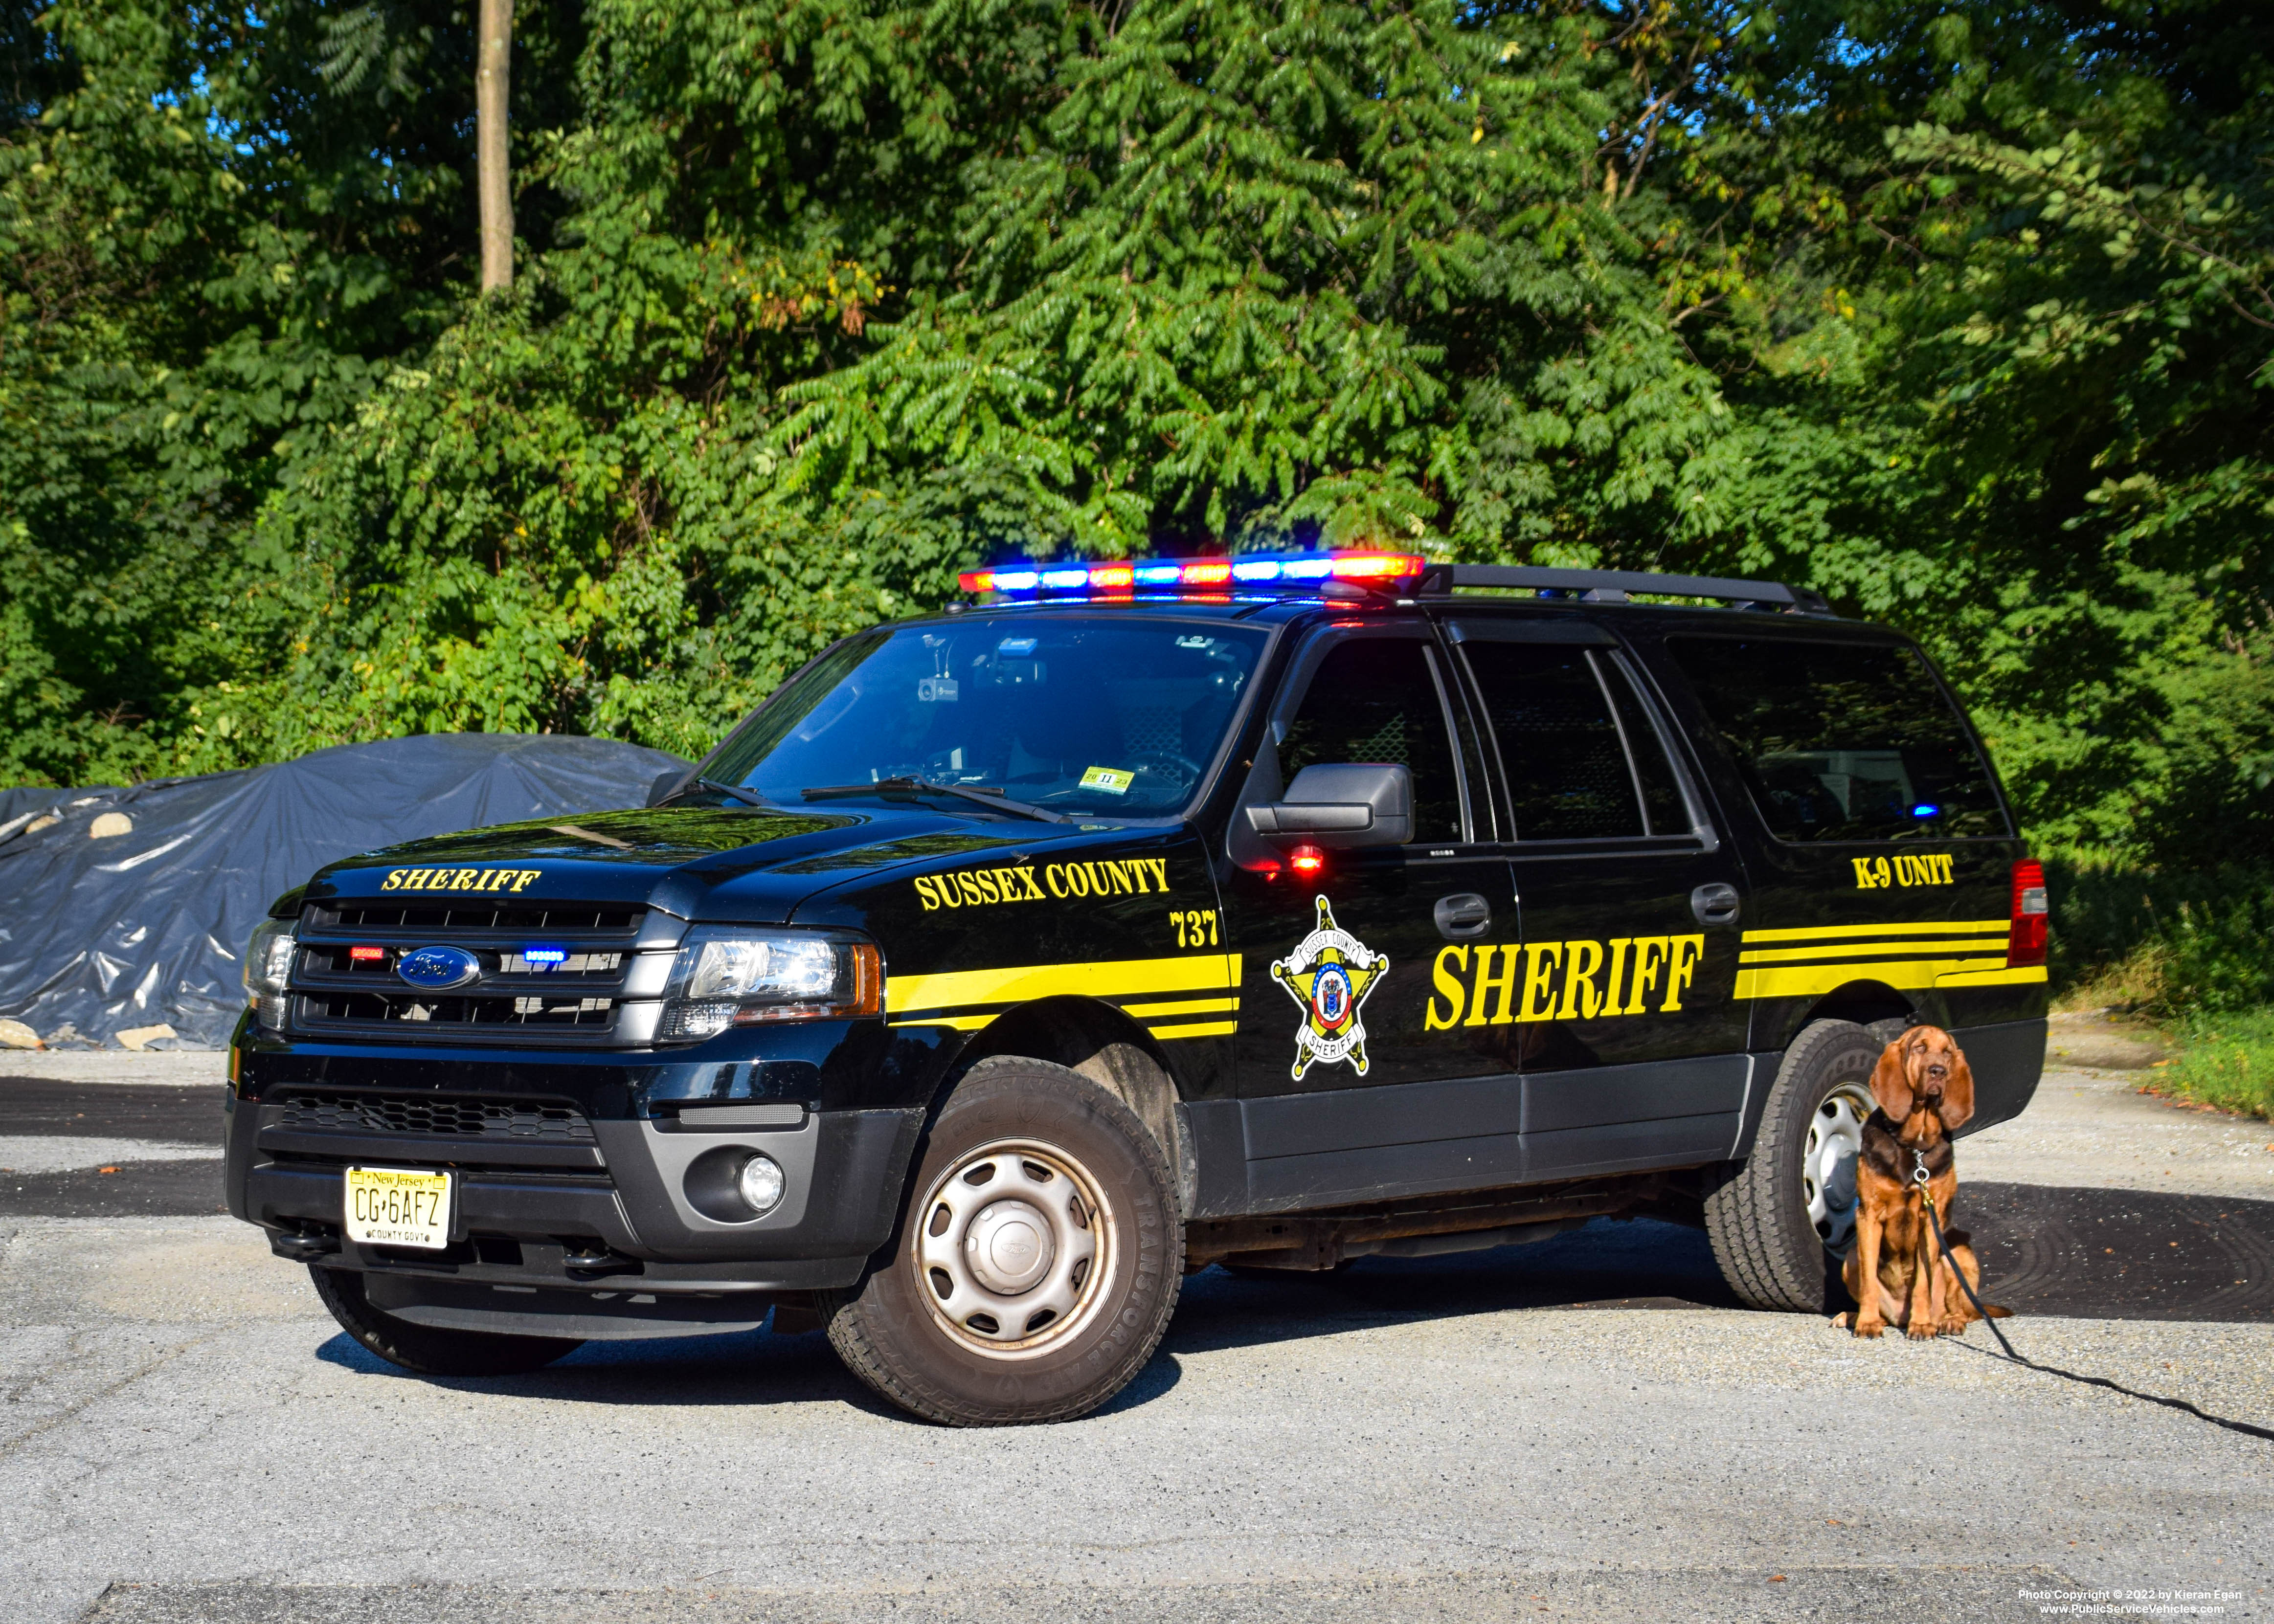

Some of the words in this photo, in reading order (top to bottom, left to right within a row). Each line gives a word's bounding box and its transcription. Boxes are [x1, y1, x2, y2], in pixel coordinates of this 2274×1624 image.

[1100, 774, 1113, 783] 11
[381, 869, 542, 892] SHERIFF
[1851, 856, 1891, 889] K-9
[1891, 854, 1954, 887] UNIT
[914, 866, 1046, 911] SUSSEX
[1045, 858, 1170, 898] COUNTY
[1170, 909, 1218, 948] 737
[1305, 932, 1328, 957] SUSSEX
[1332, 933, 1356, 956] COUNTY
[409, 953, 454, 976] Ford
[1424, 934, 1705, 1031] SHERIFF
[1309, 1032, 1353, 1056] SHERIFF
[373, 1172, 395, 1184] New
[395, 1174, 425, 1189] Jersey
[371, 1229, 402, 1241] COUNTY
[404, 1231, 424, 1242] GOVT
[1087, 1192, 1159, 1368] TRANSFORCE
